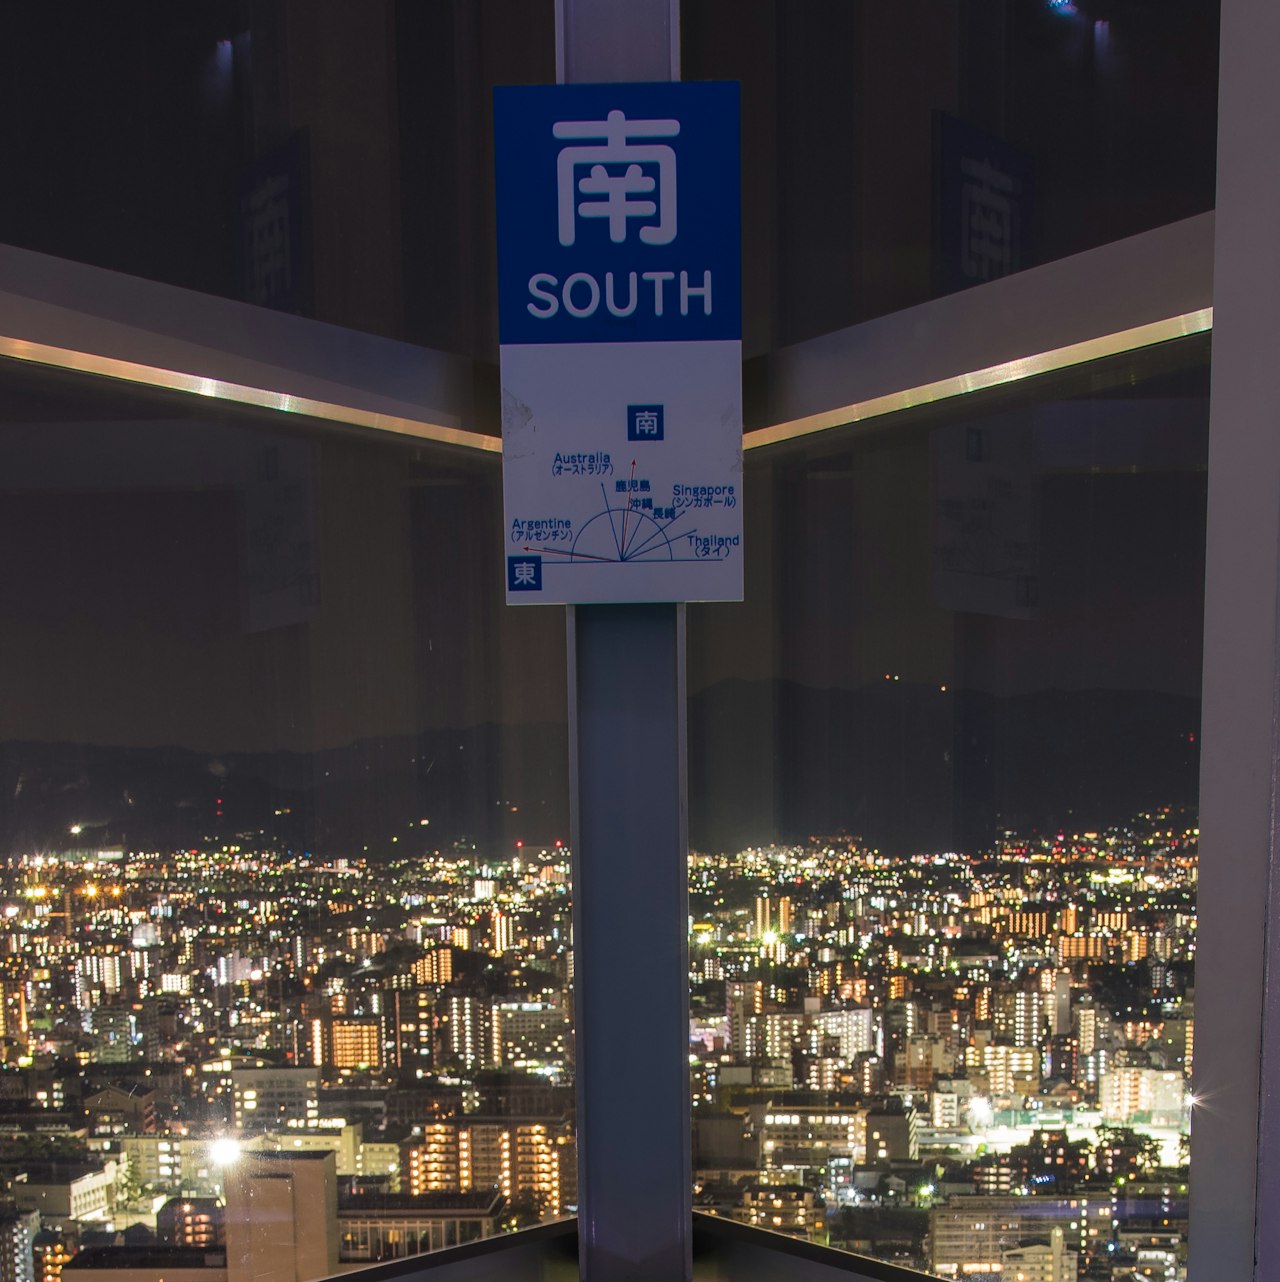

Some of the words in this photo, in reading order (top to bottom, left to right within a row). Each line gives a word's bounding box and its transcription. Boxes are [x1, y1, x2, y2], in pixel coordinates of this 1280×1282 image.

[553, 109, 680, 246] 南
[526, 270, 713, 318] SOUTH
[635, 411, 658, 434] 南
[554, 452, 611, 464] Australia
[672, 484, 735, 497] Singapore
[512, 518, 572, 532] Argentine
[687, 535, 740, 547] Thailand
[513, 562, 537, 585] 東
